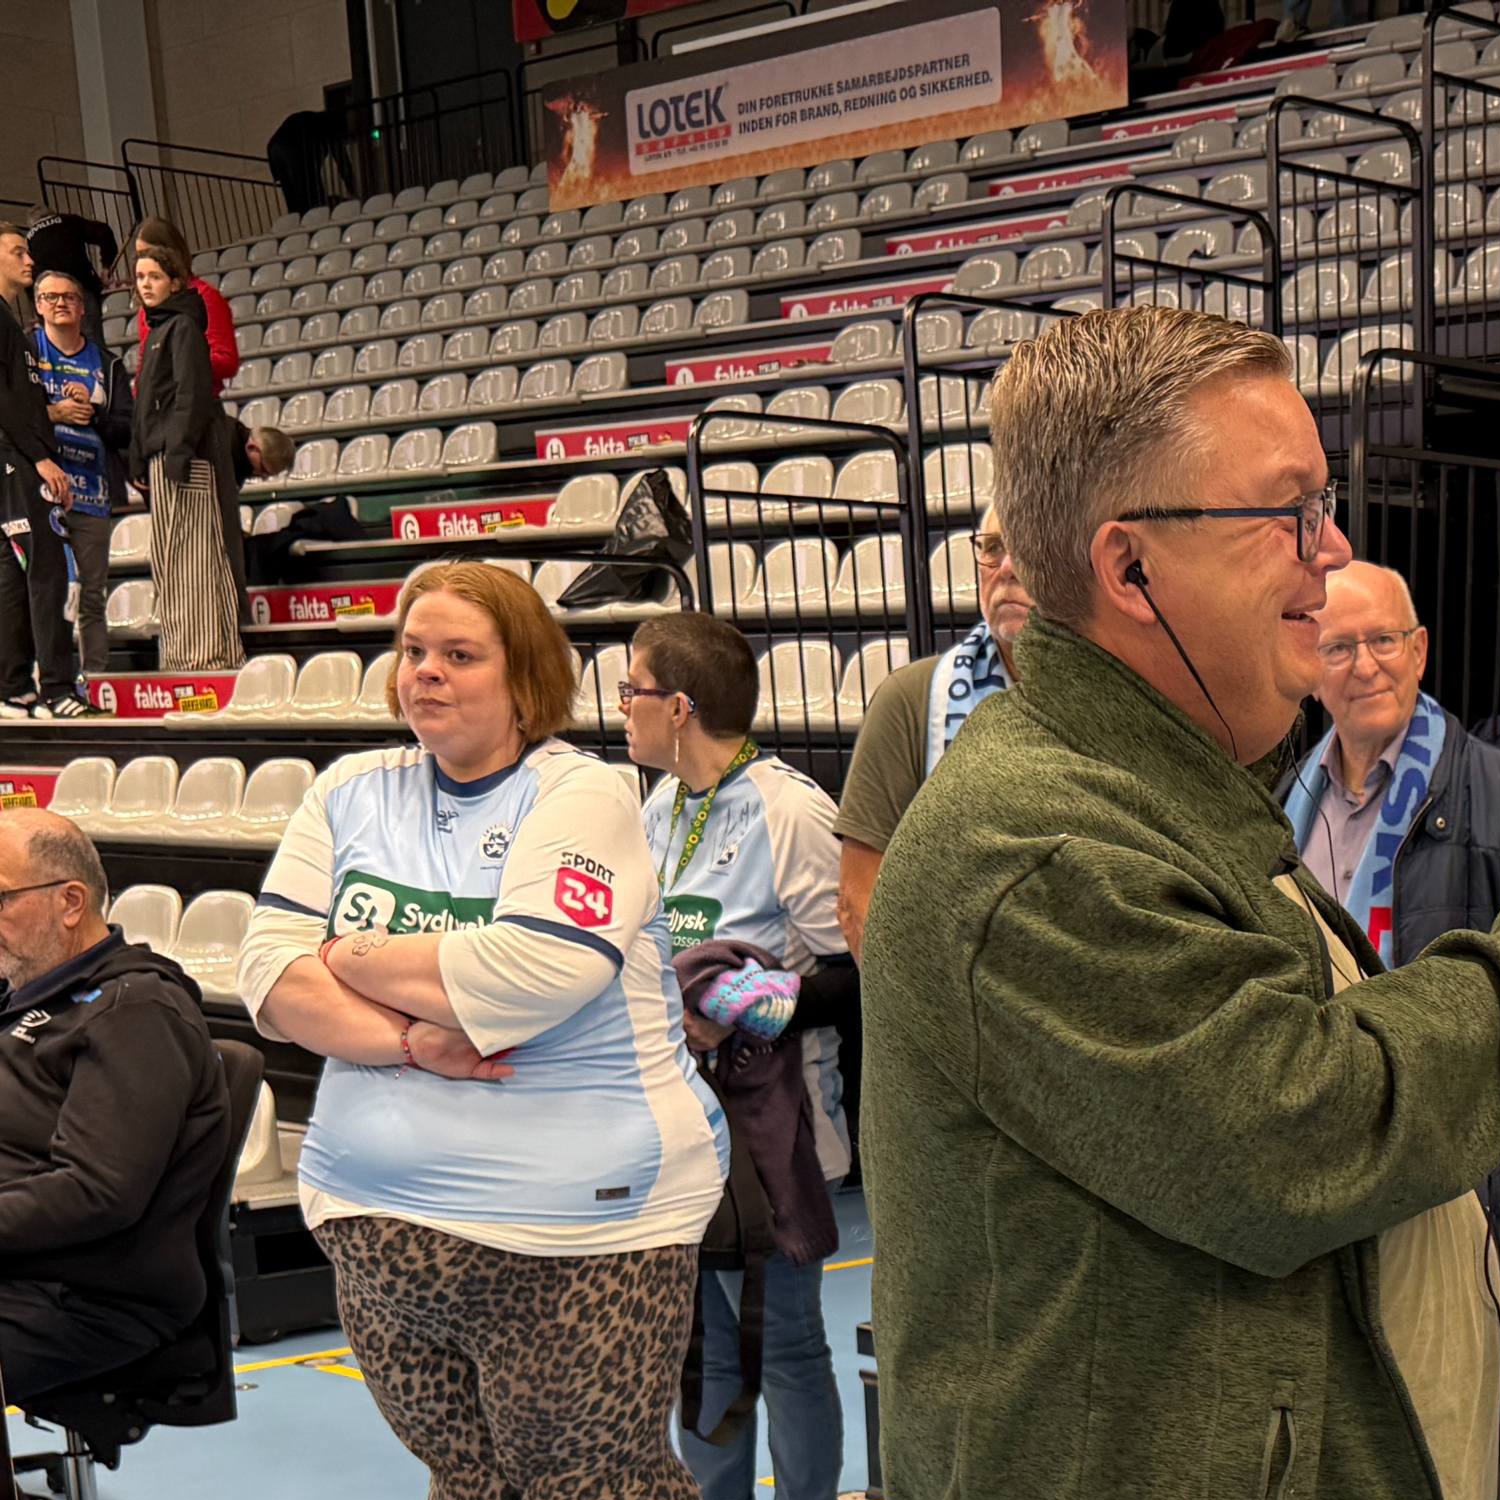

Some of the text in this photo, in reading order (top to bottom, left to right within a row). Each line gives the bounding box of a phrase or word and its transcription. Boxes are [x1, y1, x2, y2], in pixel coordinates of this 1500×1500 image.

[738, 53, 970, 116] DIN FORETRUKNE SAMARBEJDSPARTNER
[637, 84, 727, 140] LOTEK
[738, 70, 993, 135] INDEN FOR BRAND, REDNING OG SIKKERHED.
[584, 436, 626, 456] fakta
[438, 512, 479, 537] fakta
[289, 594, 330, 620] fakta
[134, 682, 174, 709] fakta
[561, 852, 616, 884] SPORT
[562, 877, 610, 920] 24
